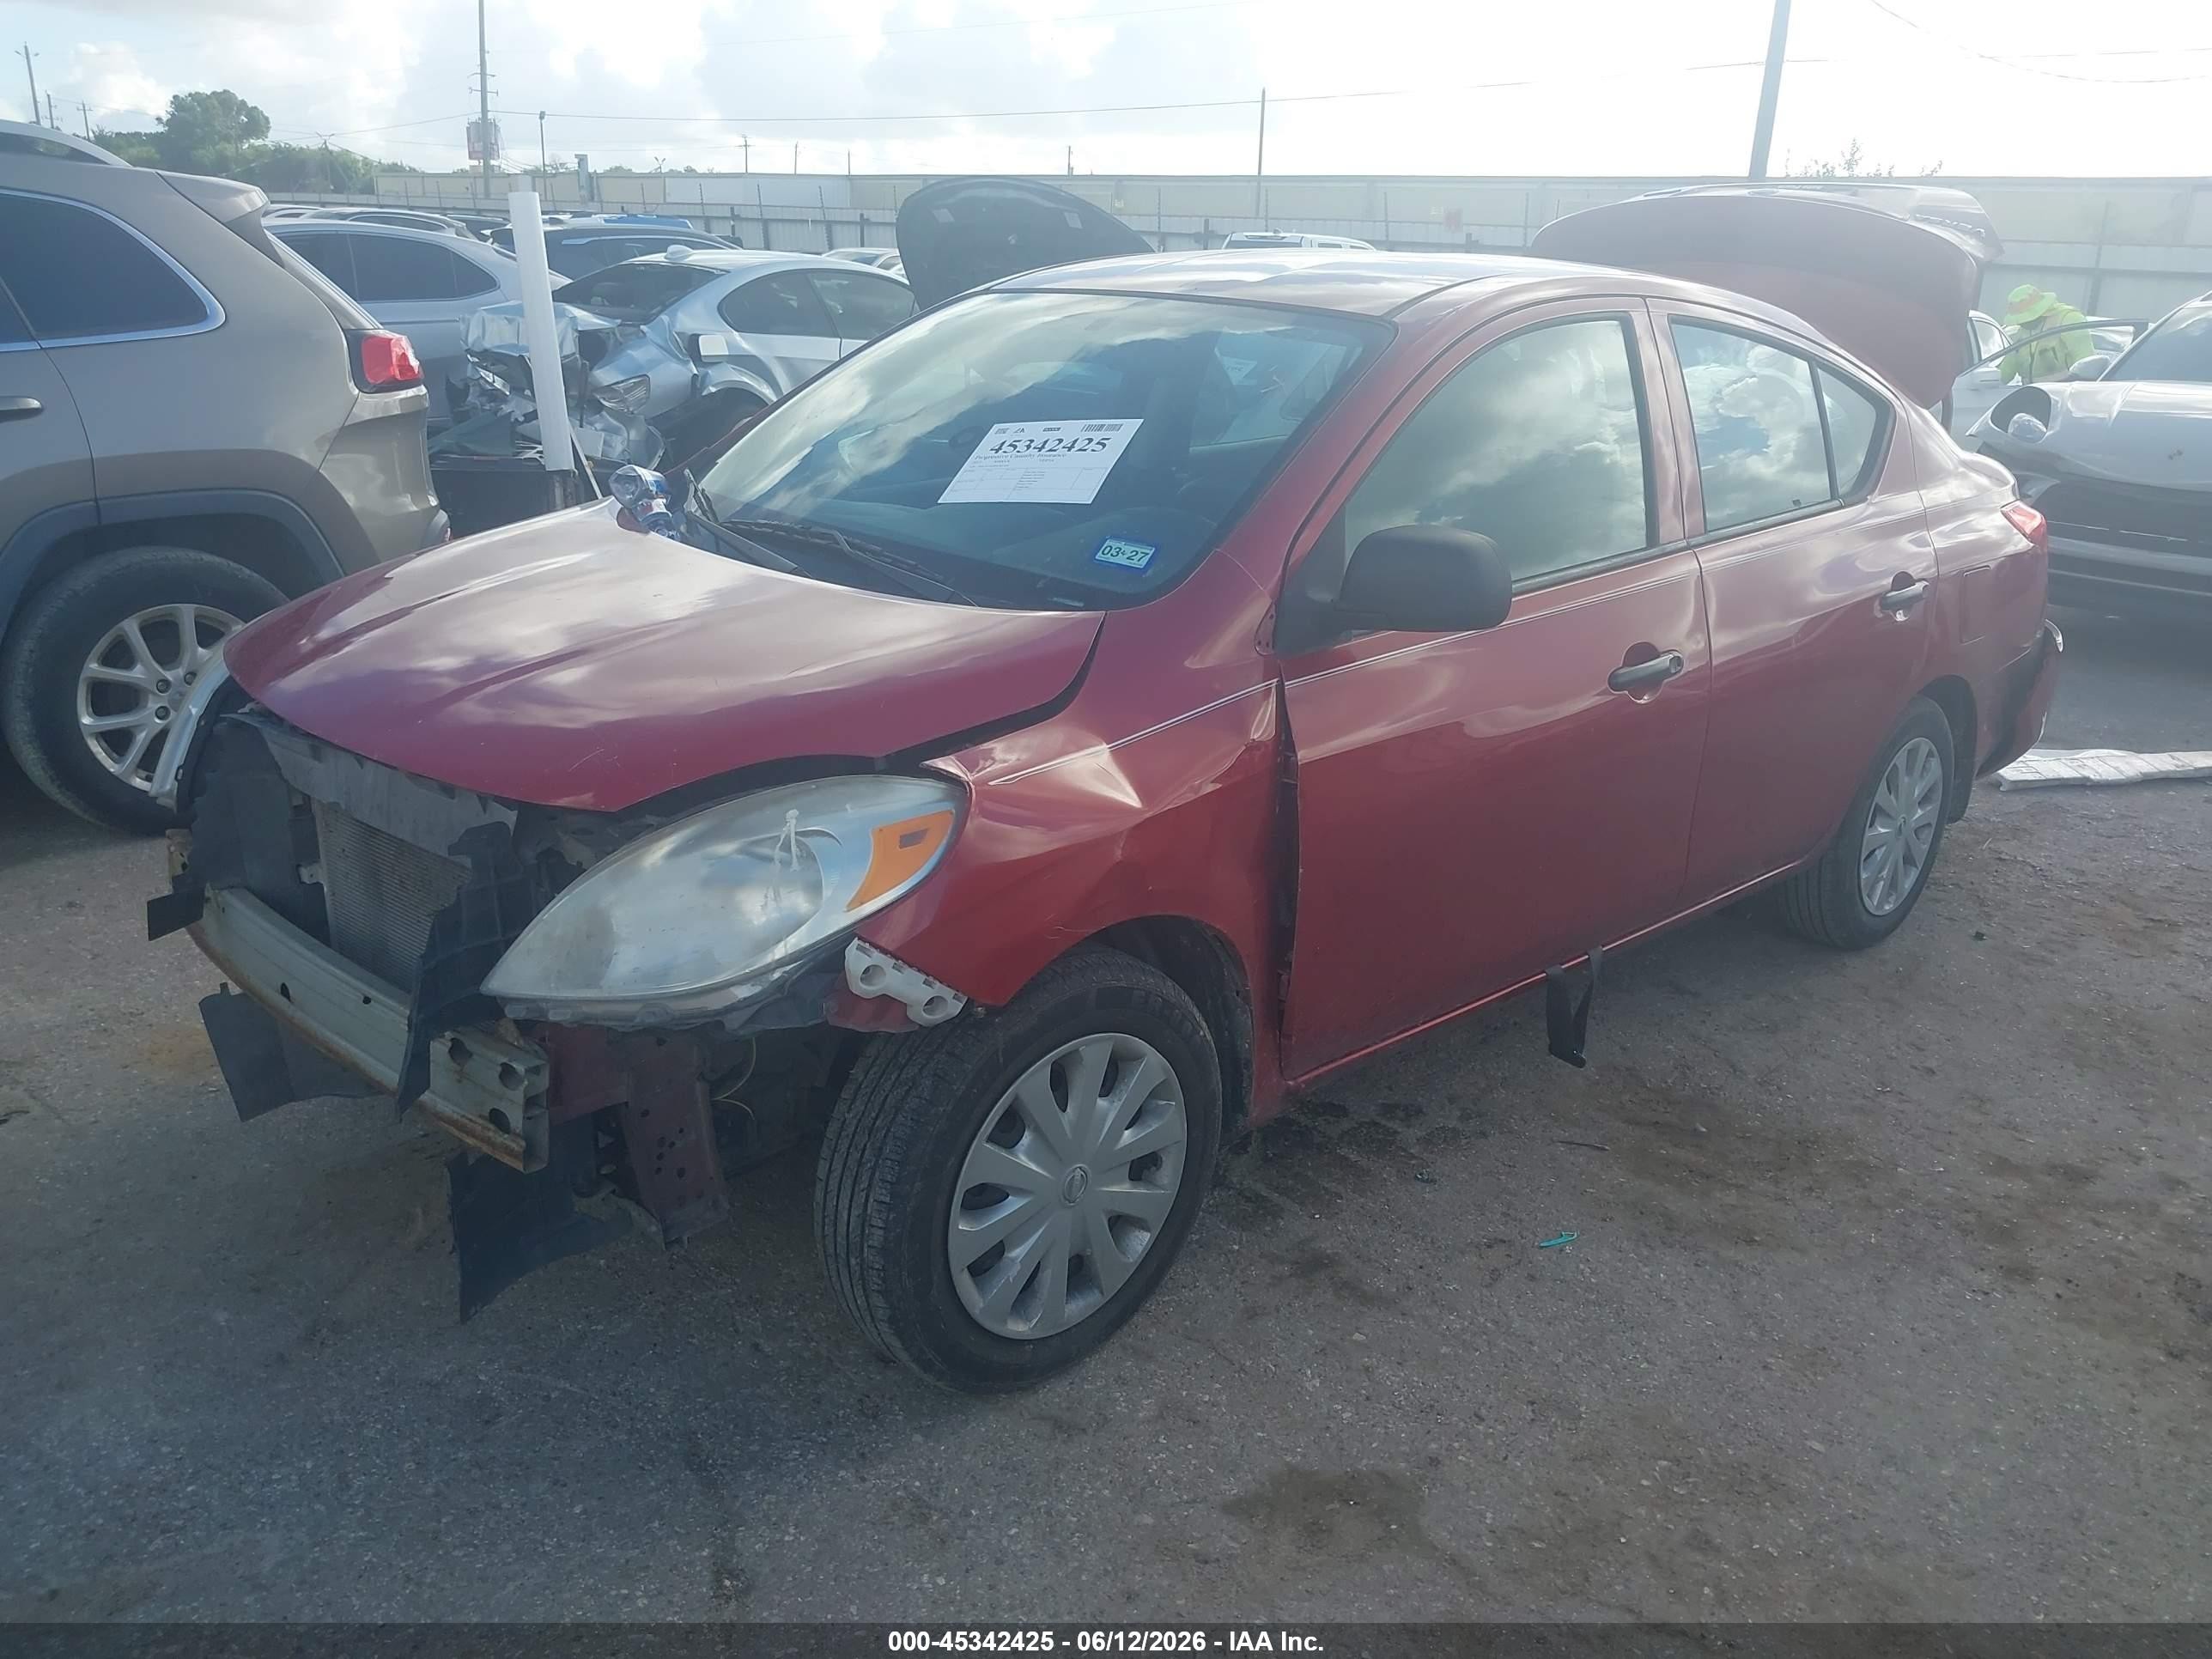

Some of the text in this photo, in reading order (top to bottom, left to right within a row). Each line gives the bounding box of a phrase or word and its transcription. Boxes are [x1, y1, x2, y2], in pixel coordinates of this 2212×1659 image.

[989, 436, 1112, 454] 45342425
[1102, 544, 1150, 562] 03 27
